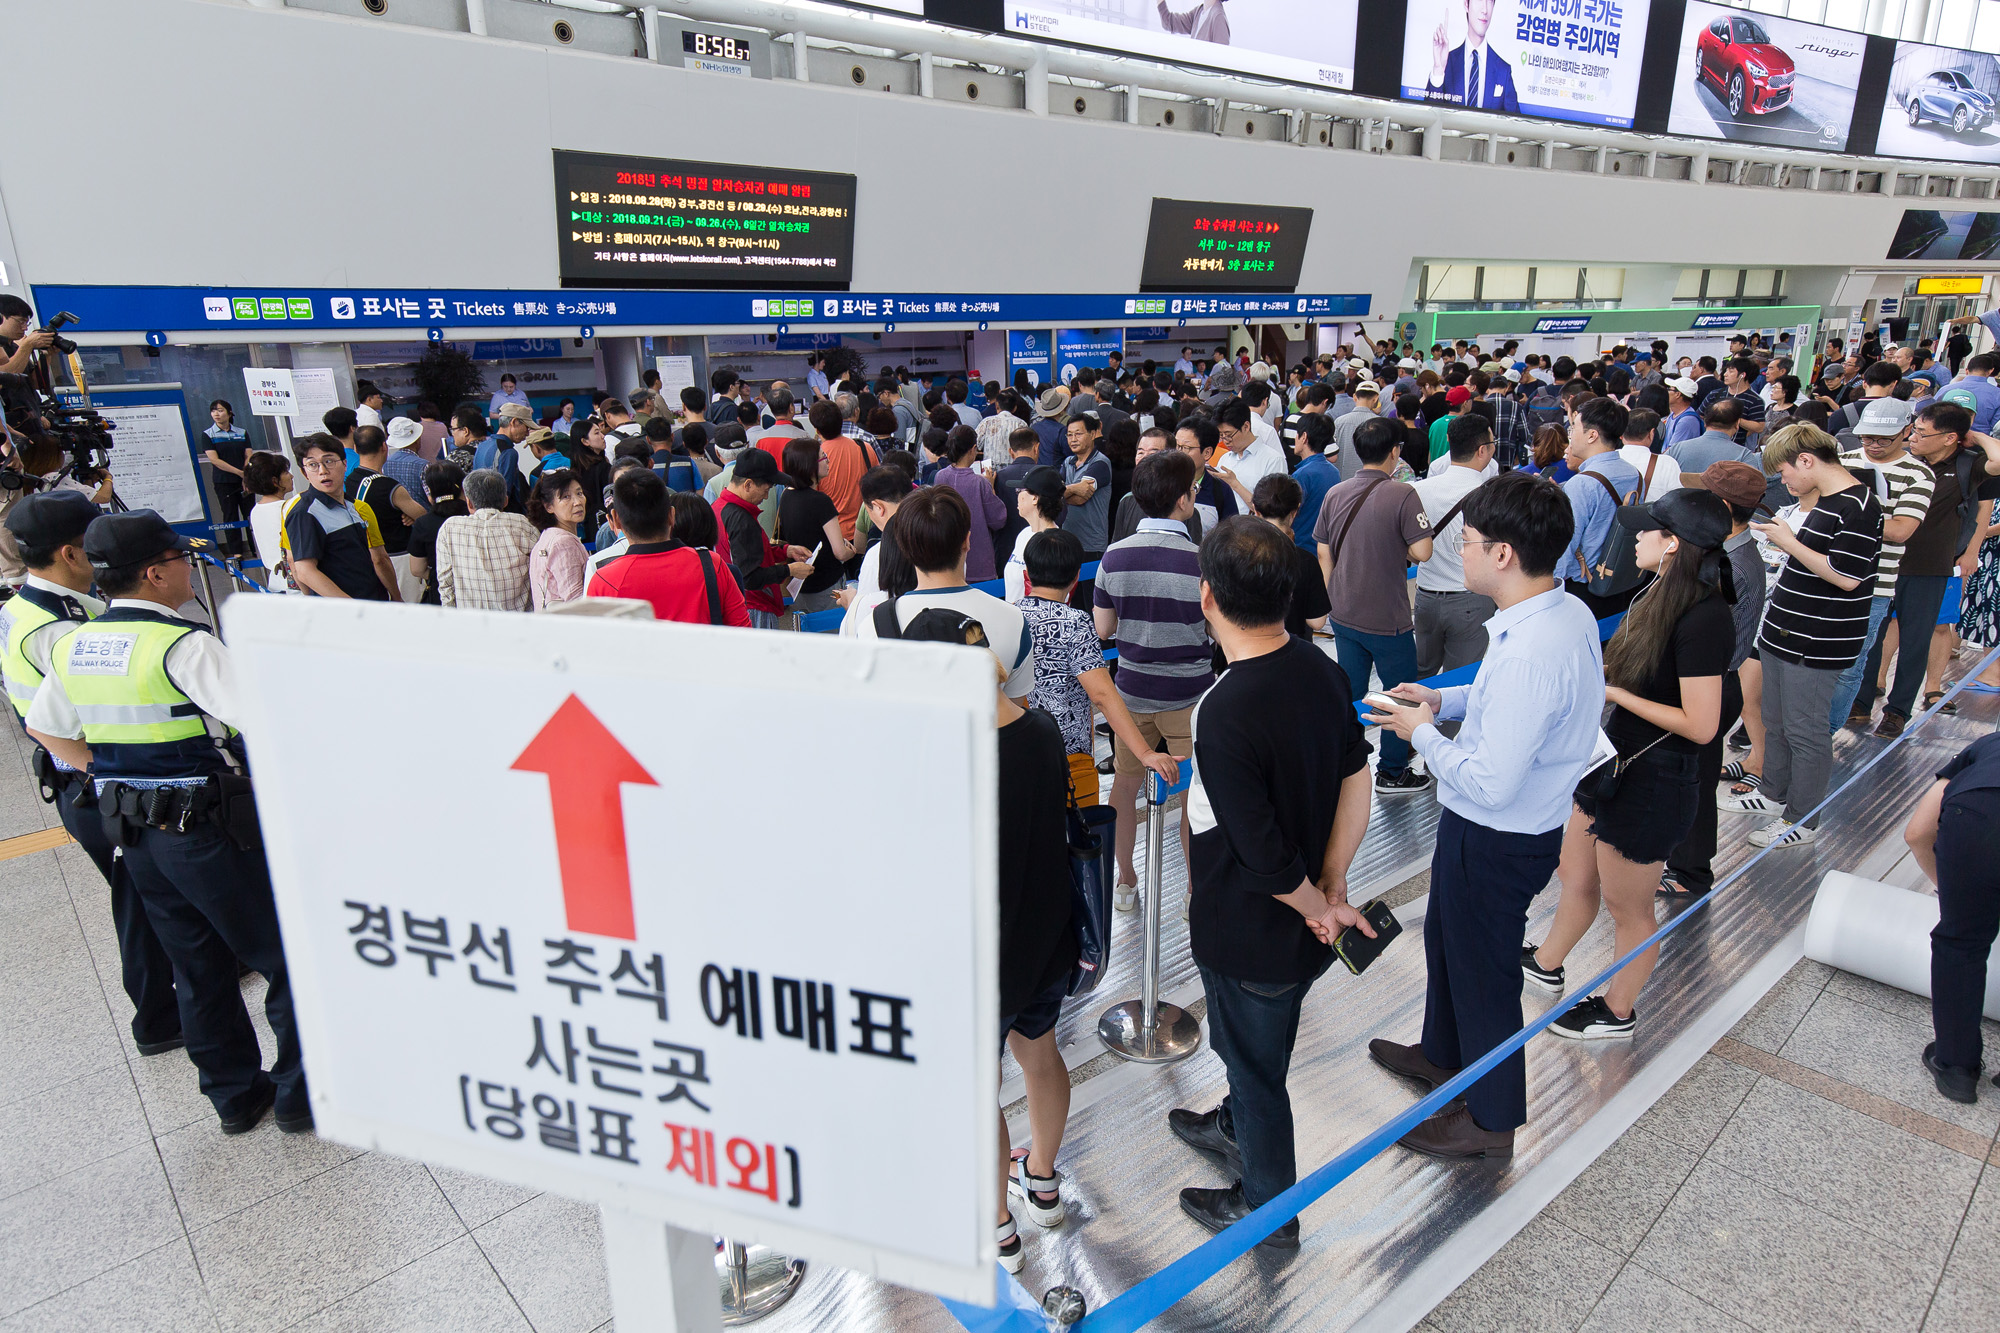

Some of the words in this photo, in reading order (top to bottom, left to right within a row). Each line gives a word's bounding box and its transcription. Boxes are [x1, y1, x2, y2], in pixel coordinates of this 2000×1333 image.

[1030, 14, 1059, 26] HYUNDAI
[1030, 22, 1051, 32] STEEL
[1516, 13, 1562, 47] 감염병
[1564, 23, 1621, 59] 주의지역
[1795, 43, 1859, 58] stinger
[1528, 54, 1543, 67] 나의
[1542, 57, 1581, 74] 해외여행지는
[1581, 63, 1610, 79] 건강할까?
[1318, 69, 1344, 84] 현대제철
[616, 171, 656, 188] 2018년
[660, 174, 683, 189] 추석
[685, 176, 709, 191] 명절
[767, 182, 789, 196] 예매
[791, 184, 811, 198] 알림
[580, 192, 600, 203] 일정
[678, 198, 724, 211] 경부,경전선
[727, 201, 736, 212] 등
[581, 211, 602, 223] 대상
[612, 213, 685, 228] 2018.09.21.(금)
[695, 217, 741, 231] 09.26.(수),
[743, 219, 767, 232] 6일간
[768, 220, 810, 233] 열차승차권
[1193, 218, 1211, 230] 오늘
[1212, 219, 1236, 232] 승차권
[1237, 220, 1254, 233] 사는
[1255, 222, 1264, 233] 곳
[582, 231, 603, 244] 방법
[613, 232, 704, 247] 홈페이지(7시~15시),
[705, 236, 715, 247] 역
[718, 237, 780, 250] 창구(9시~11시)
[1198, 239, 1214, 251] 서부
[1216, 240, 1227, 251] 10
[1237, 240, 1254, 252] 12번
[1256, 241, 1271, 253] 창구
[594, 252, 611, 262] 기타
[613, 252, 638, 262] 사항은
[823, 258, 836, 268] 확인
[1183, 258, 1225, 271] 자동발매기,
[1227, 260, 1241, 271] 3층
[1242, 260, 1266, 272] 표사는
[1266, 260, 1275, 272] 곳
[262, 303, 283, 311] 무궁화
[289, 303, 309, 311] 누리로
[362, 298, 420, 319] 표사는
[428, 298, 446, 319] 곳
[453, 301, 505, 316] Tickets
[512, 302, 549, 316] 售票处
[556, 302, 617, 316] きっぷ売り場
[842, 299, 877, 316] 표사는
[882, 299, 894, 316] 곳
[898, 301, 930, 313] Tickets
[934, 302, 957, 313] 售票处
[961, 301, 1000, 313] きっぷ売り場
[1183, 300, 1207, 313] 표사는
[1209, 300, 1218, 313] 곳
[1219, 302, 1242, 311] Tickets
[432, 330, 440, 340] 2
[584, 328, 591, 337] 3
[780, 326, 786, 334] 4
[152, 335, 159, 345] 1
[520, 338, 555, 352] 30%
[261, 380, 276, 388] 경부선
[252, 389, 262, 397] 추석
[263, 389, 273, 397] 예매
[274, 390, 290, 398] 대기줄
[208, 523, 235, 531] KORAIL
[74, 639, 129, 656] 철도경찰
[345, 899, 517, 992] 경부선
[544, 938, 670, 1022] 추석
[699, 962, 917, 1064] 예매표
[524, 1015, 711, 1113] 사는곳
[663, 1121, 802, 1208] 제외]
